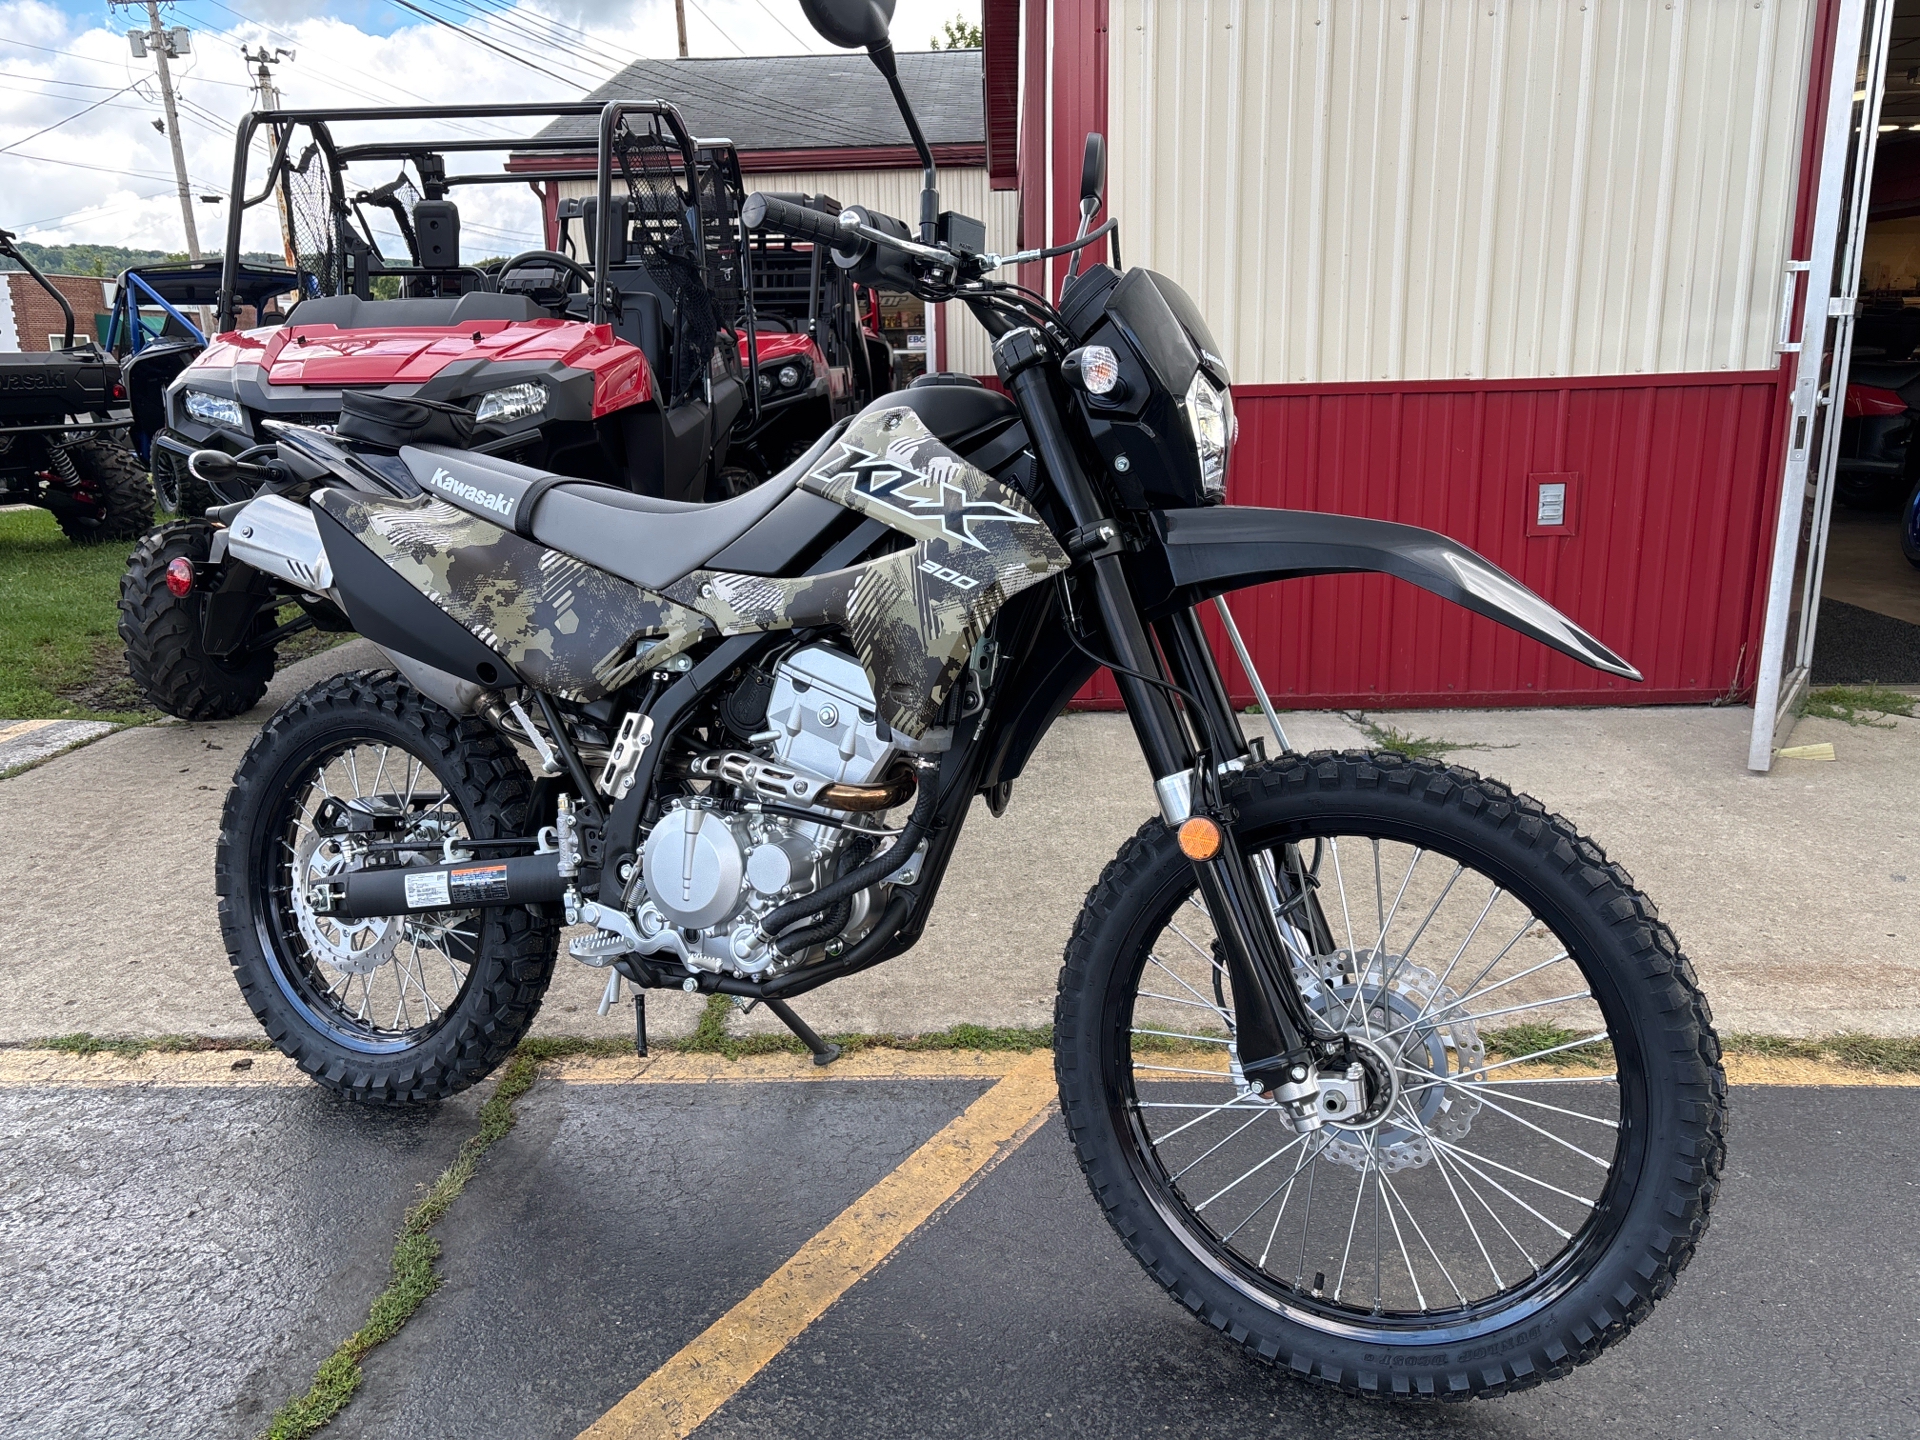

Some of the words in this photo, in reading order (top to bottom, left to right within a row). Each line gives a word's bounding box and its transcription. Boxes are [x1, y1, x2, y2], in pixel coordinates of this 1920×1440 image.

[908, 334, 926, 344] EBC
[430, 467, 515, 516] Kawasaki
[810, 442, 1039, 552] KLX
[917, 560, 980, 590] 300
[1457, 1324, 1542, 1363] DUNLOP
